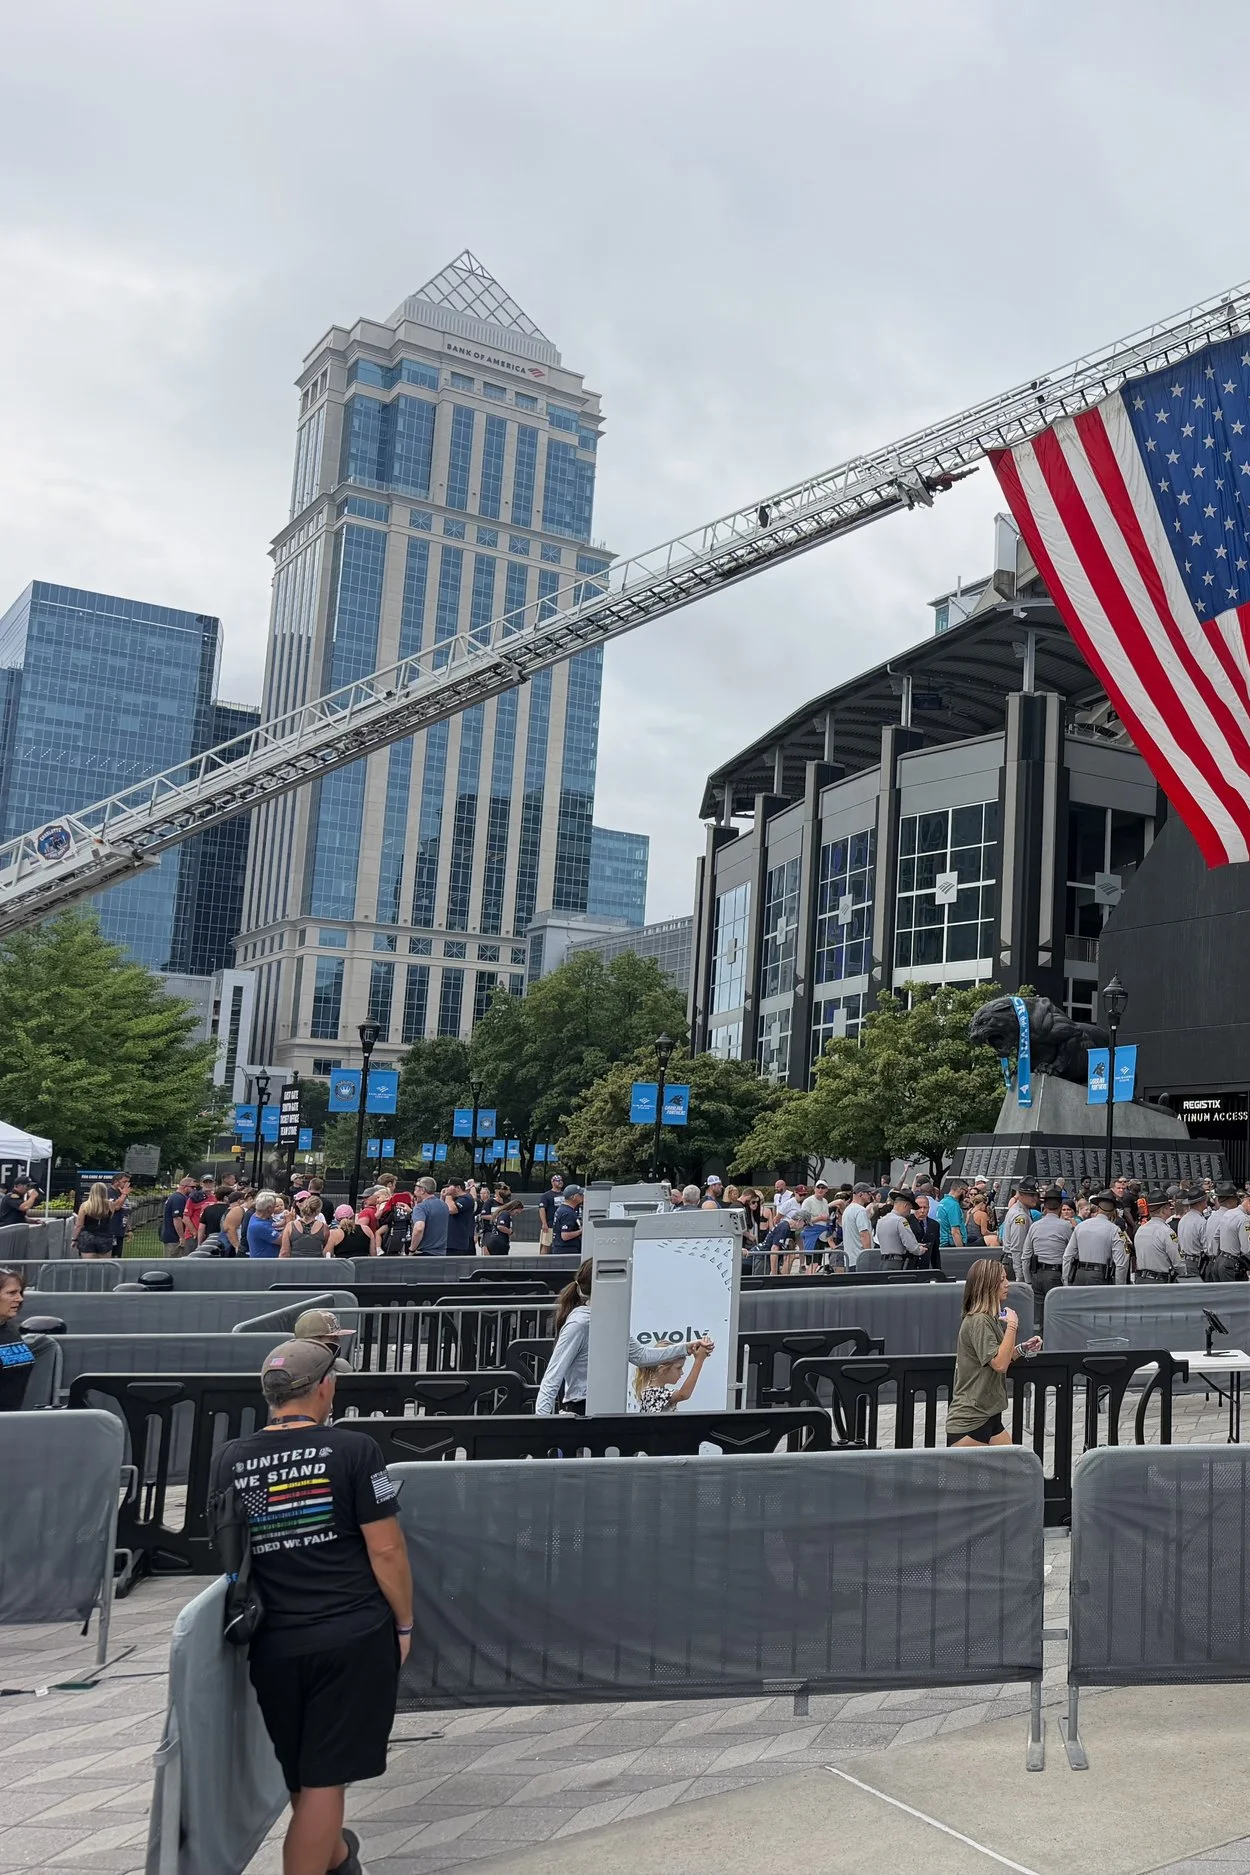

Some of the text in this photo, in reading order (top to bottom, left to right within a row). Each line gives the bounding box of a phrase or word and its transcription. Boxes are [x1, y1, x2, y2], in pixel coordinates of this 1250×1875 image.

[446, 343, 526, 374] BANK OF AMERICA
[1177, 1112, 1249, 1122] ATINUM ACCESS
[1183, 1100, 1221, 1110] REGISTIX
[246, 1447, 317, 1471] UNITED
[234, 1475, 260, 1490] WE
[267, 1463, 326, 1483] STAND
[252, 1531, 338, 1556] IDED WE FALL
